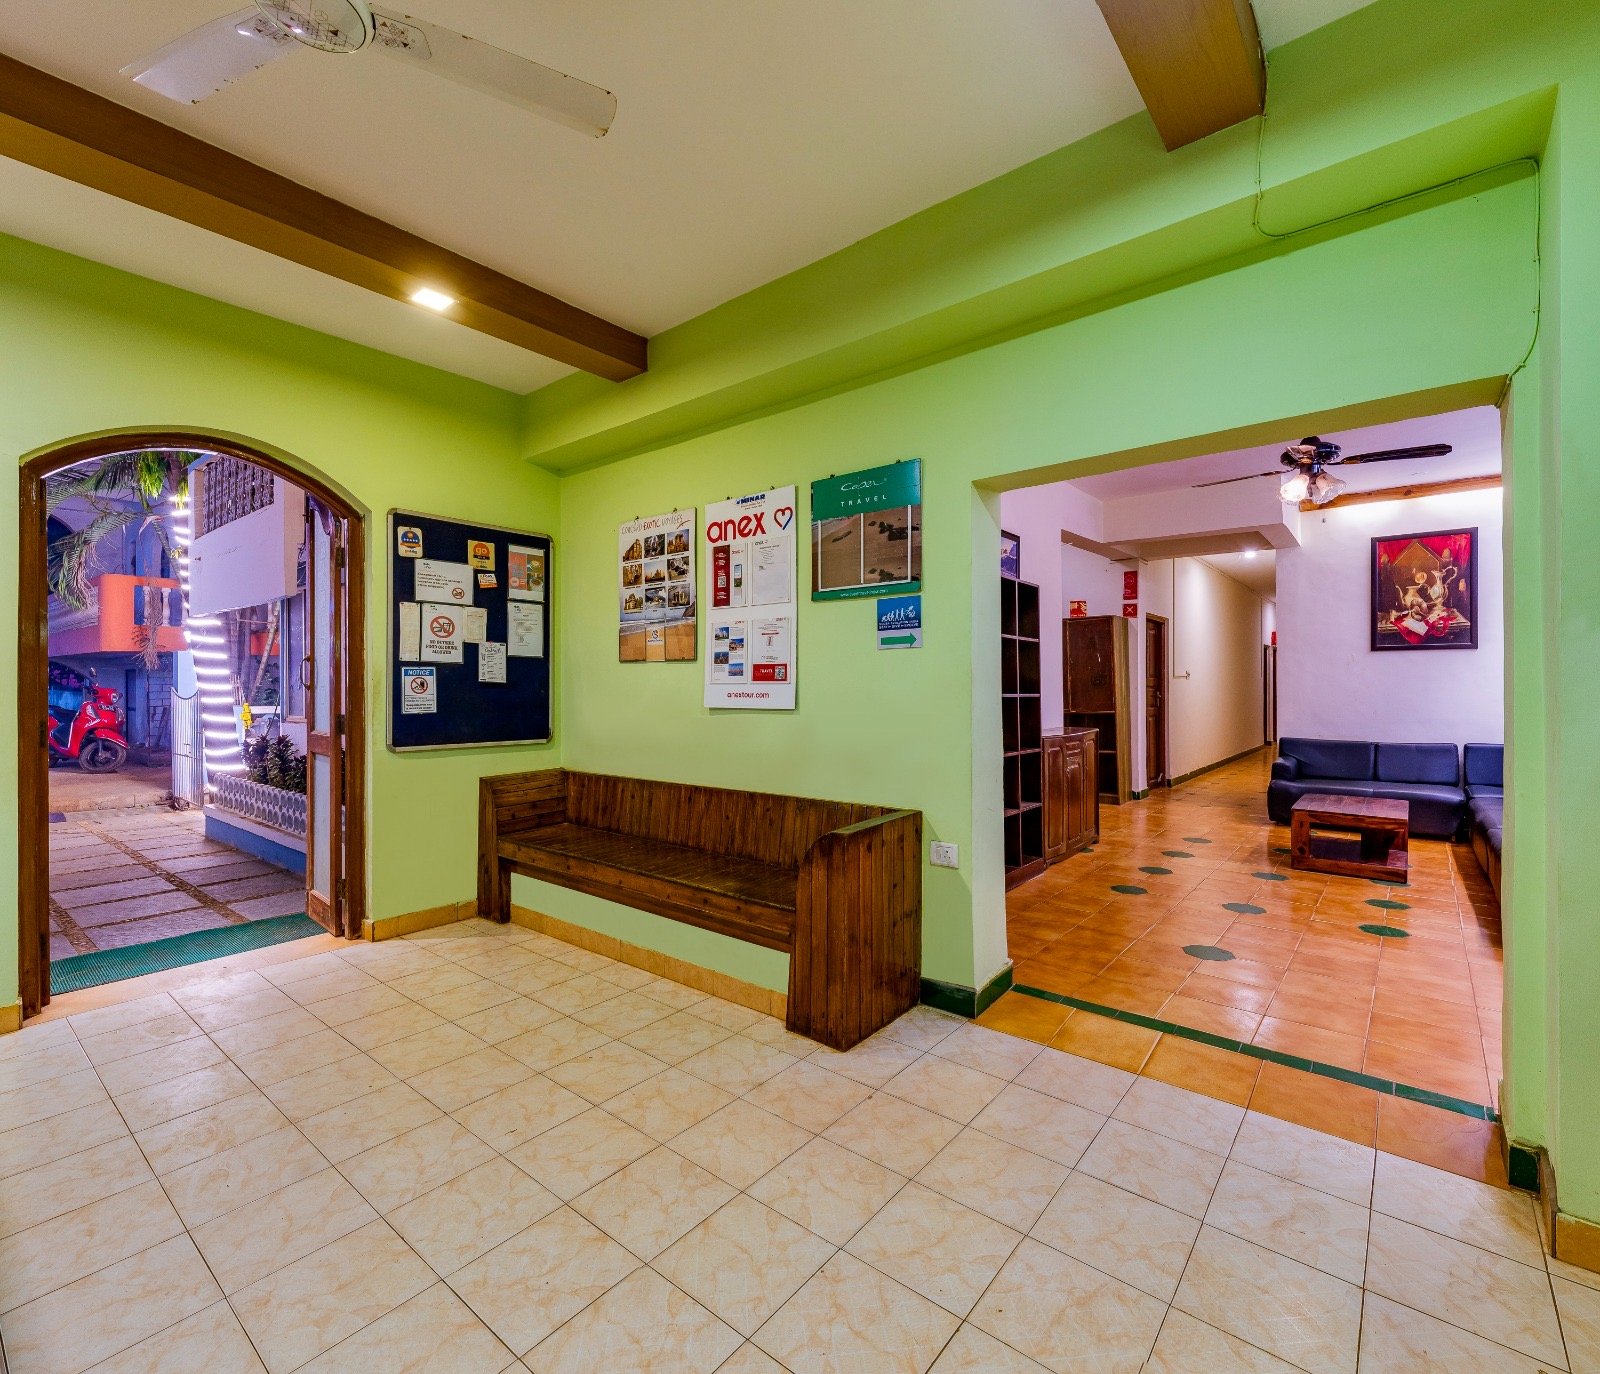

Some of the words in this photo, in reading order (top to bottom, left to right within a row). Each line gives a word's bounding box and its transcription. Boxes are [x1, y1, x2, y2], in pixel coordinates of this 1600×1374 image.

[740, 493, 766, 504] MINAR
[840, 494, 887, 507] TRAVEL
[643, 519, 660, 531] EXOTIC
[706, 511, 767, 543] anex
